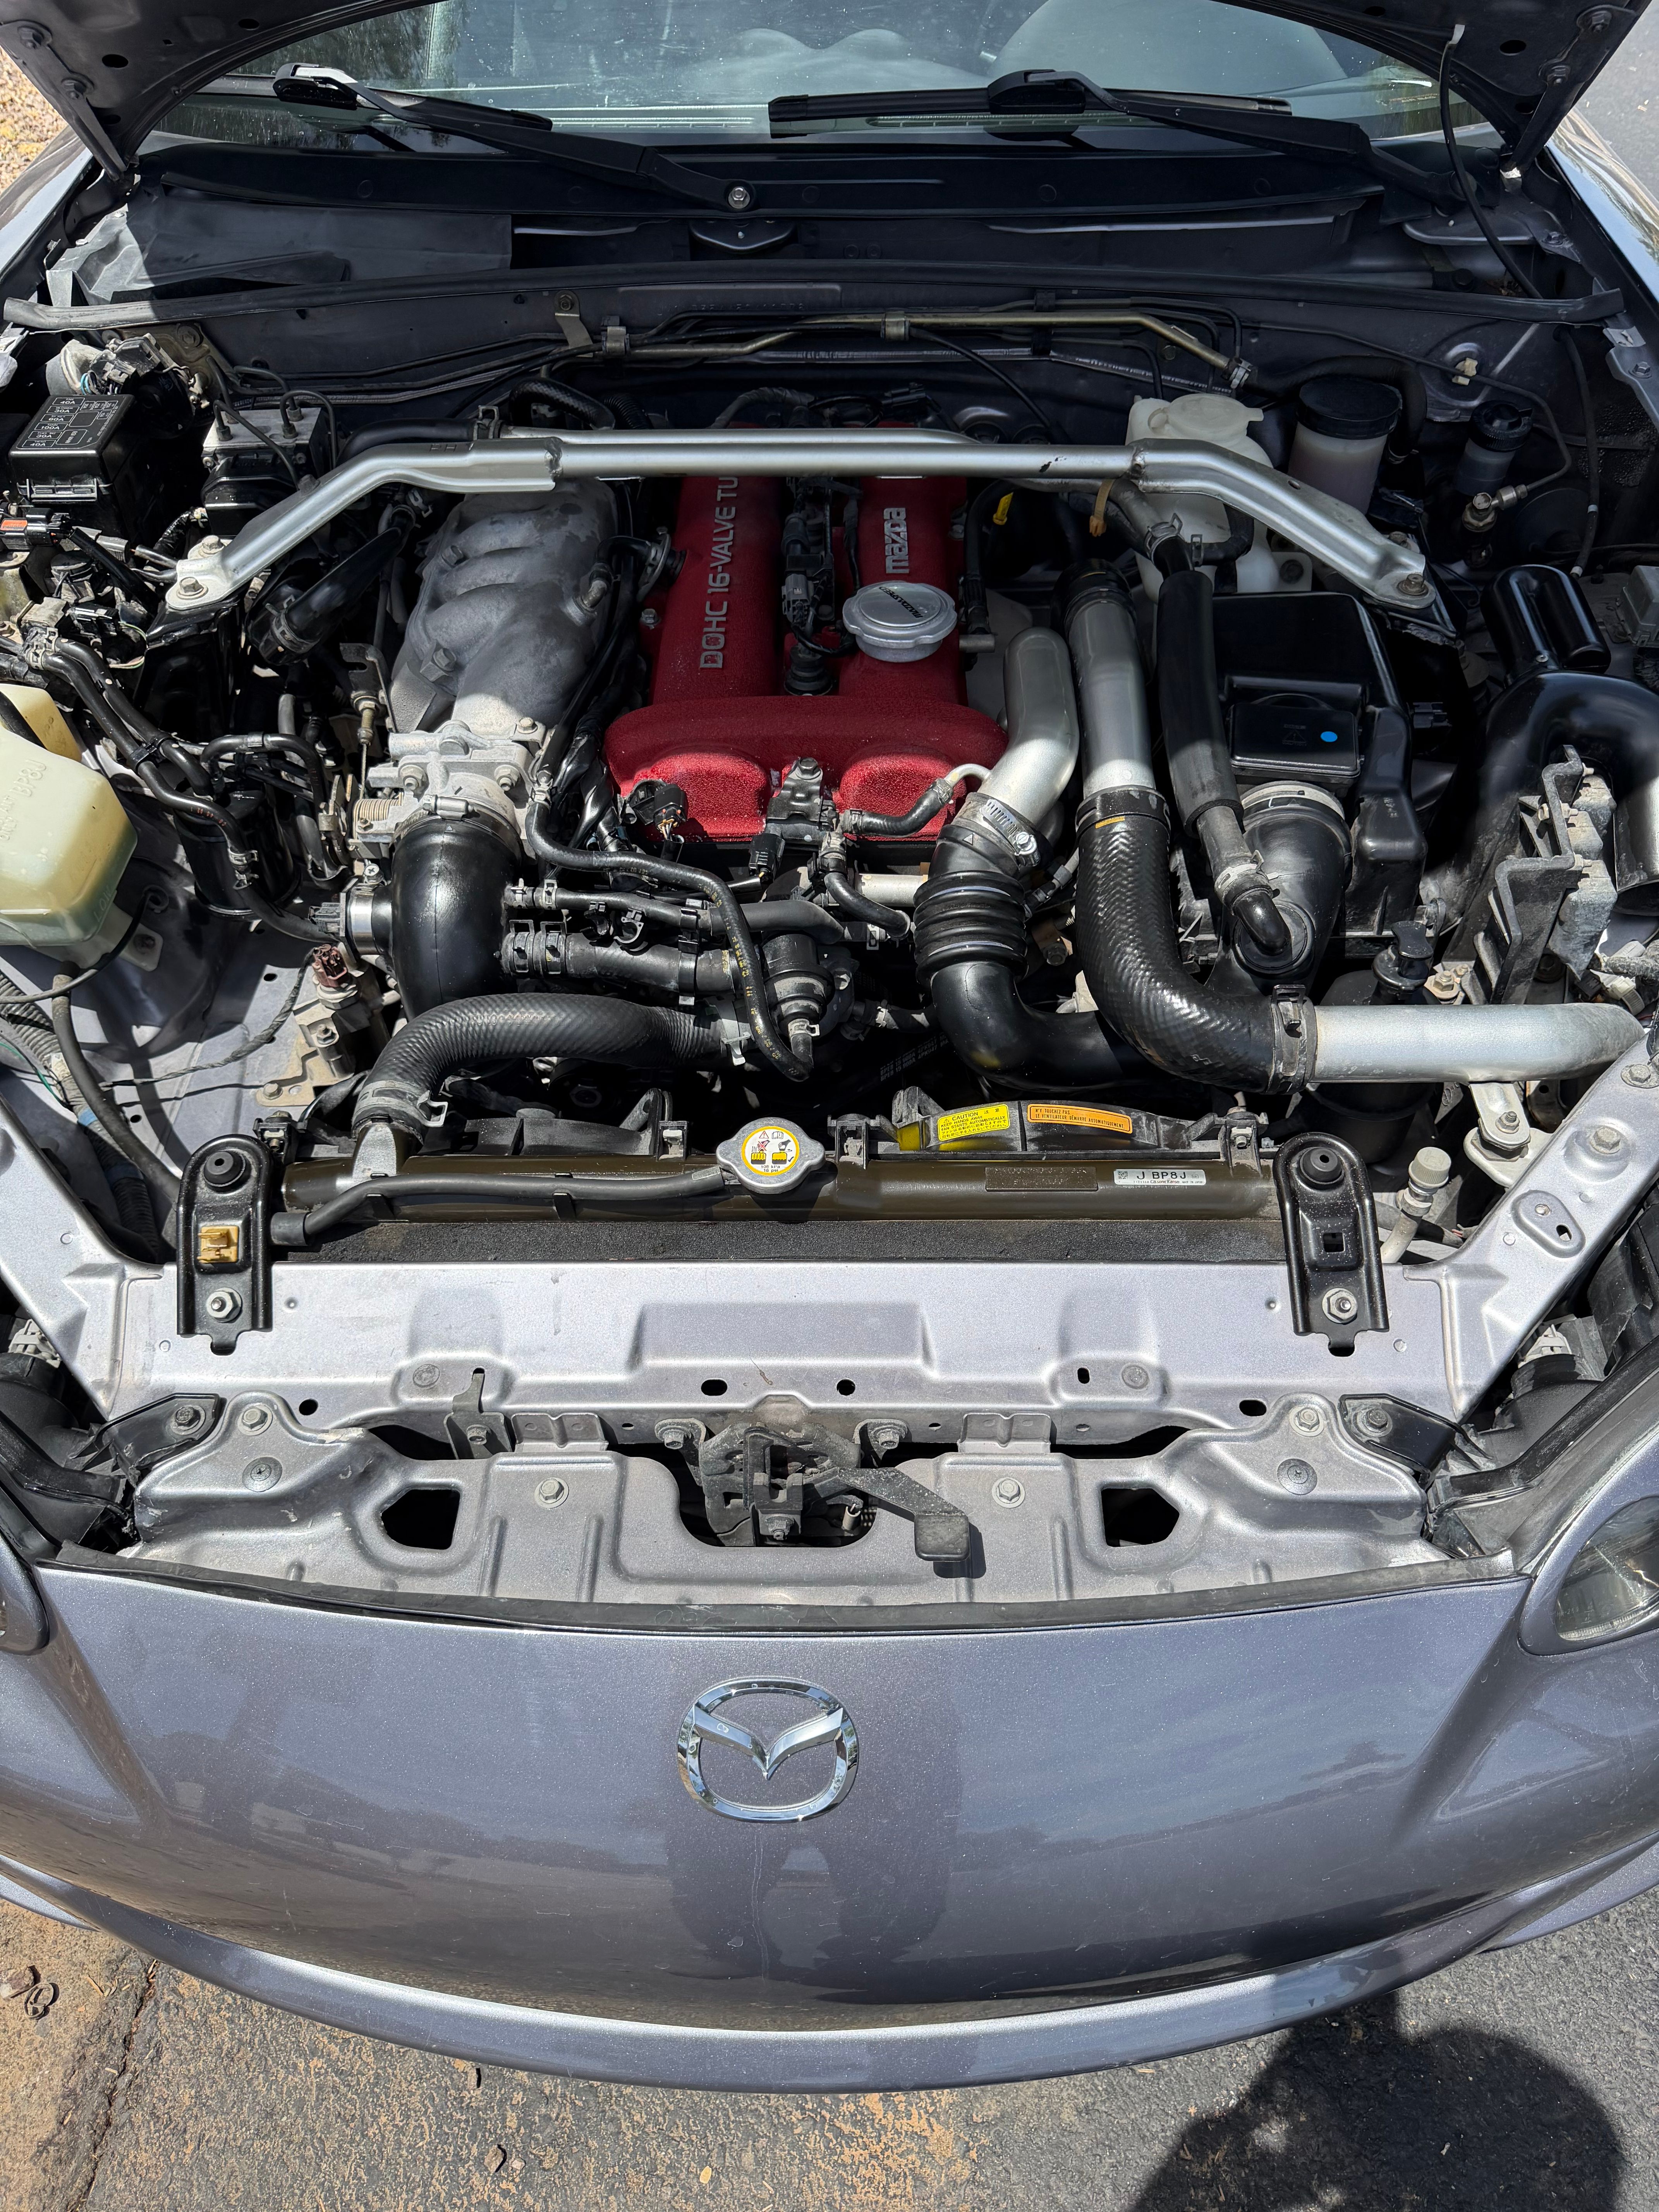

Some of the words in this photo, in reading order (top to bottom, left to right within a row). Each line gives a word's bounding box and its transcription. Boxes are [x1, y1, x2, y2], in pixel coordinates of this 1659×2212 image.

[707, 507, 736, 594] 16-VALVE
[879, 586, 923, 618] MAZDASPEED
[700, 601, 728, 668] DOHC
[9, 759, 46, 797] BP8J
[952, 1111, 978, 1121] CAUTION
[1137, 1171, 1145, 1180] J
